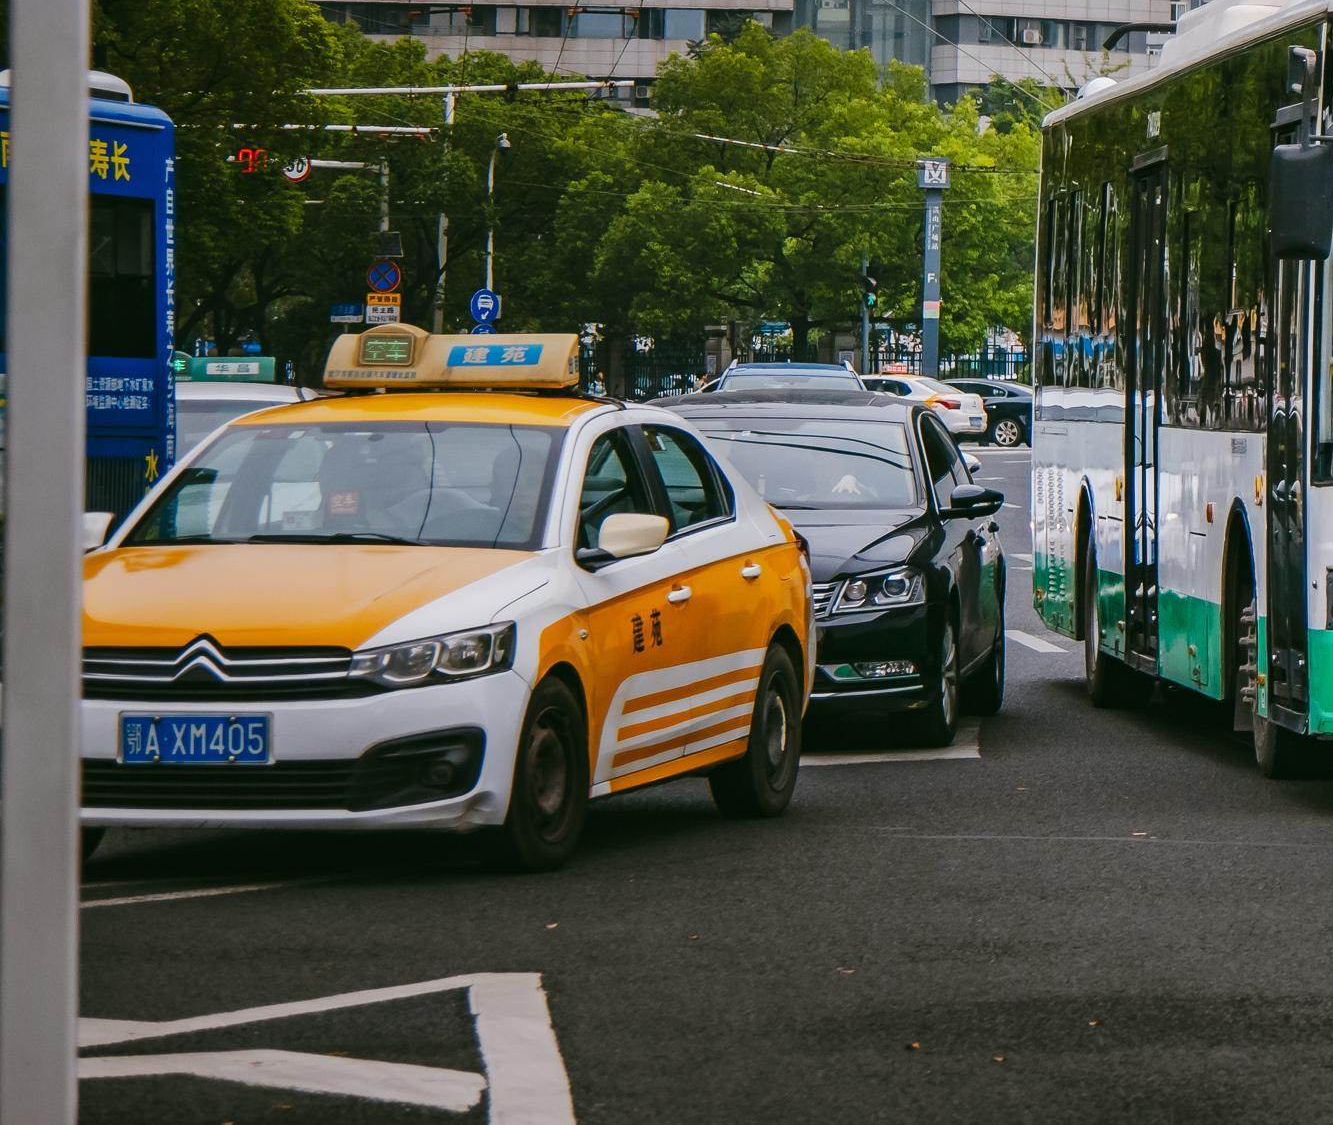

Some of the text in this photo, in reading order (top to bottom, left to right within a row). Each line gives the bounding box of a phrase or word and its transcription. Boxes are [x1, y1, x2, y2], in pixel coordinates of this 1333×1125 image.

[165, 157, 175, 472] 产自世界长寿之乡海南
[463, 347, 529, 364] 建苑
[631, 608, 663, 653] 建苑
